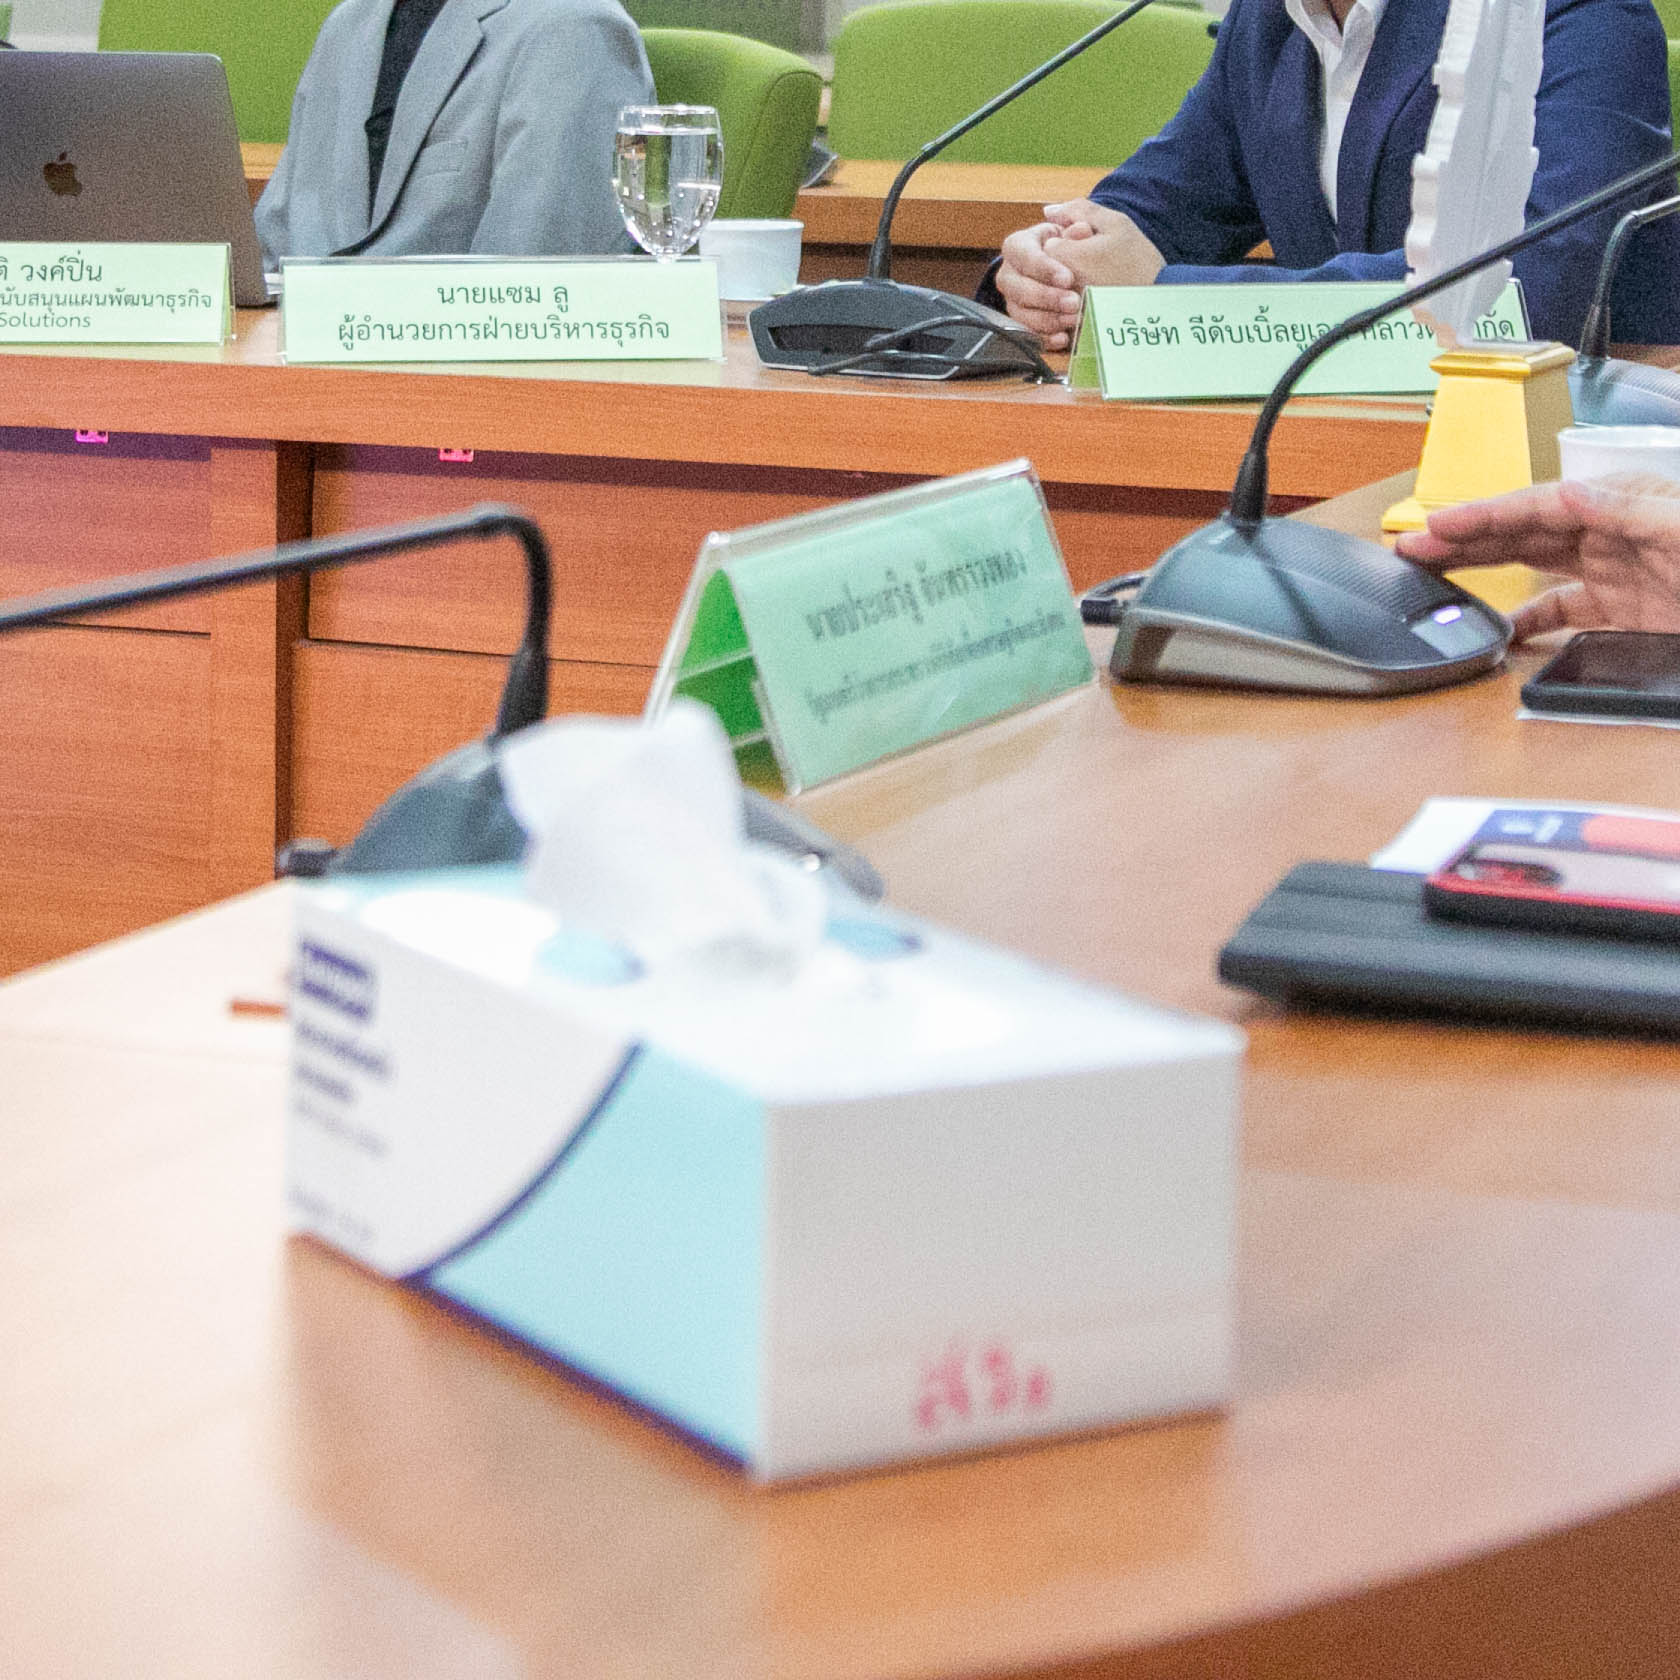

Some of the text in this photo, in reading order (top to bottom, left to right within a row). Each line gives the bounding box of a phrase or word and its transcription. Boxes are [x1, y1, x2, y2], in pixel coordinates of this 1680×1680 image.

[20, 250, 103, 283] วงค์ปิ่น
[437, 284, 570, 313] นายแซม ลู
[338, 313, 670, 351] ผู้อำนวยการฝ่ายบริหารธุรกิจ
[1107, 316, 1180, 346] บริษัท
[1189, 305, 1350, 352] จีดับเบิ้ลยูเอ
